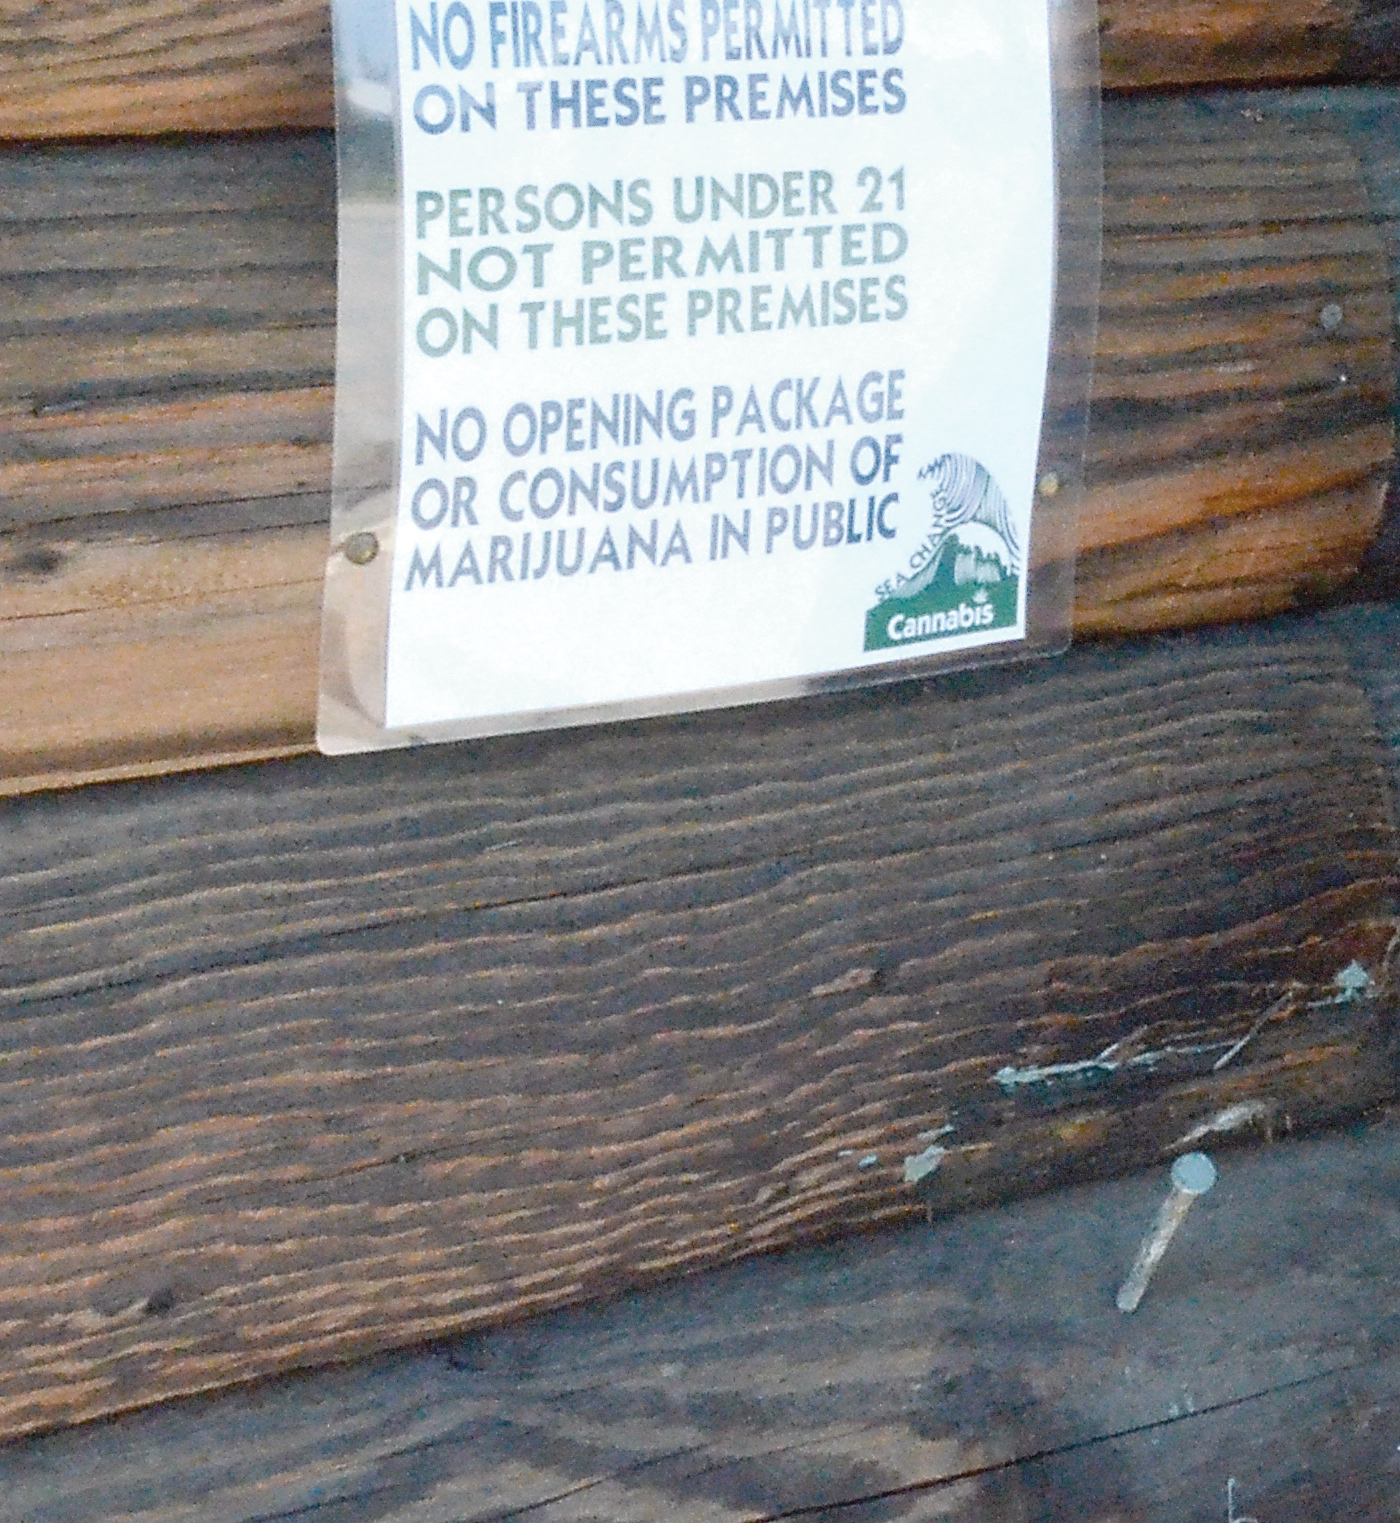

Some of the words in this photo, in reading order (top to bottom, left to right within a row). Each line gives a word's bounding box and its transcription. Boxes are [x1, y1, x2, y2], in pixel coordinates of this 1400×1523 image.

[409, 1, 475, 71] NO
[413, 82, 496, 135] ON
[516, 76, 665, 130] THESE
[684, 67, 906, 124] PREMISES
[416, 179, 653, 238] PERSONS
[673, 169, 839, 224] UNDER
[857, 165, 906, 211] 21
[418, 242, 553, 296] NOT
[580, 222, 909, 285] PERMITTED
[416, 305, 499, 358] ON
[520, 292, 666, 350] THESE
[687, 275, 908, 338] PREMISES
[415, 407, 487, 465] NO
[503, 387, 696, 454] OPENING
[713, 368, 906, 436] PACKAGE
[411, 477, 477, 531] OR
[499, 446, 834, 521] CONSUMPTION
[849, 434, 903, 487] OF
[404, 518, 692, 592] MARIJUANA
[709, 509, 751, 560] IN
[765, 492, 900, 555] PUBLIC
[875, 572, 910, 602] SEA
[887, 603, 994, 640] Cannabis
